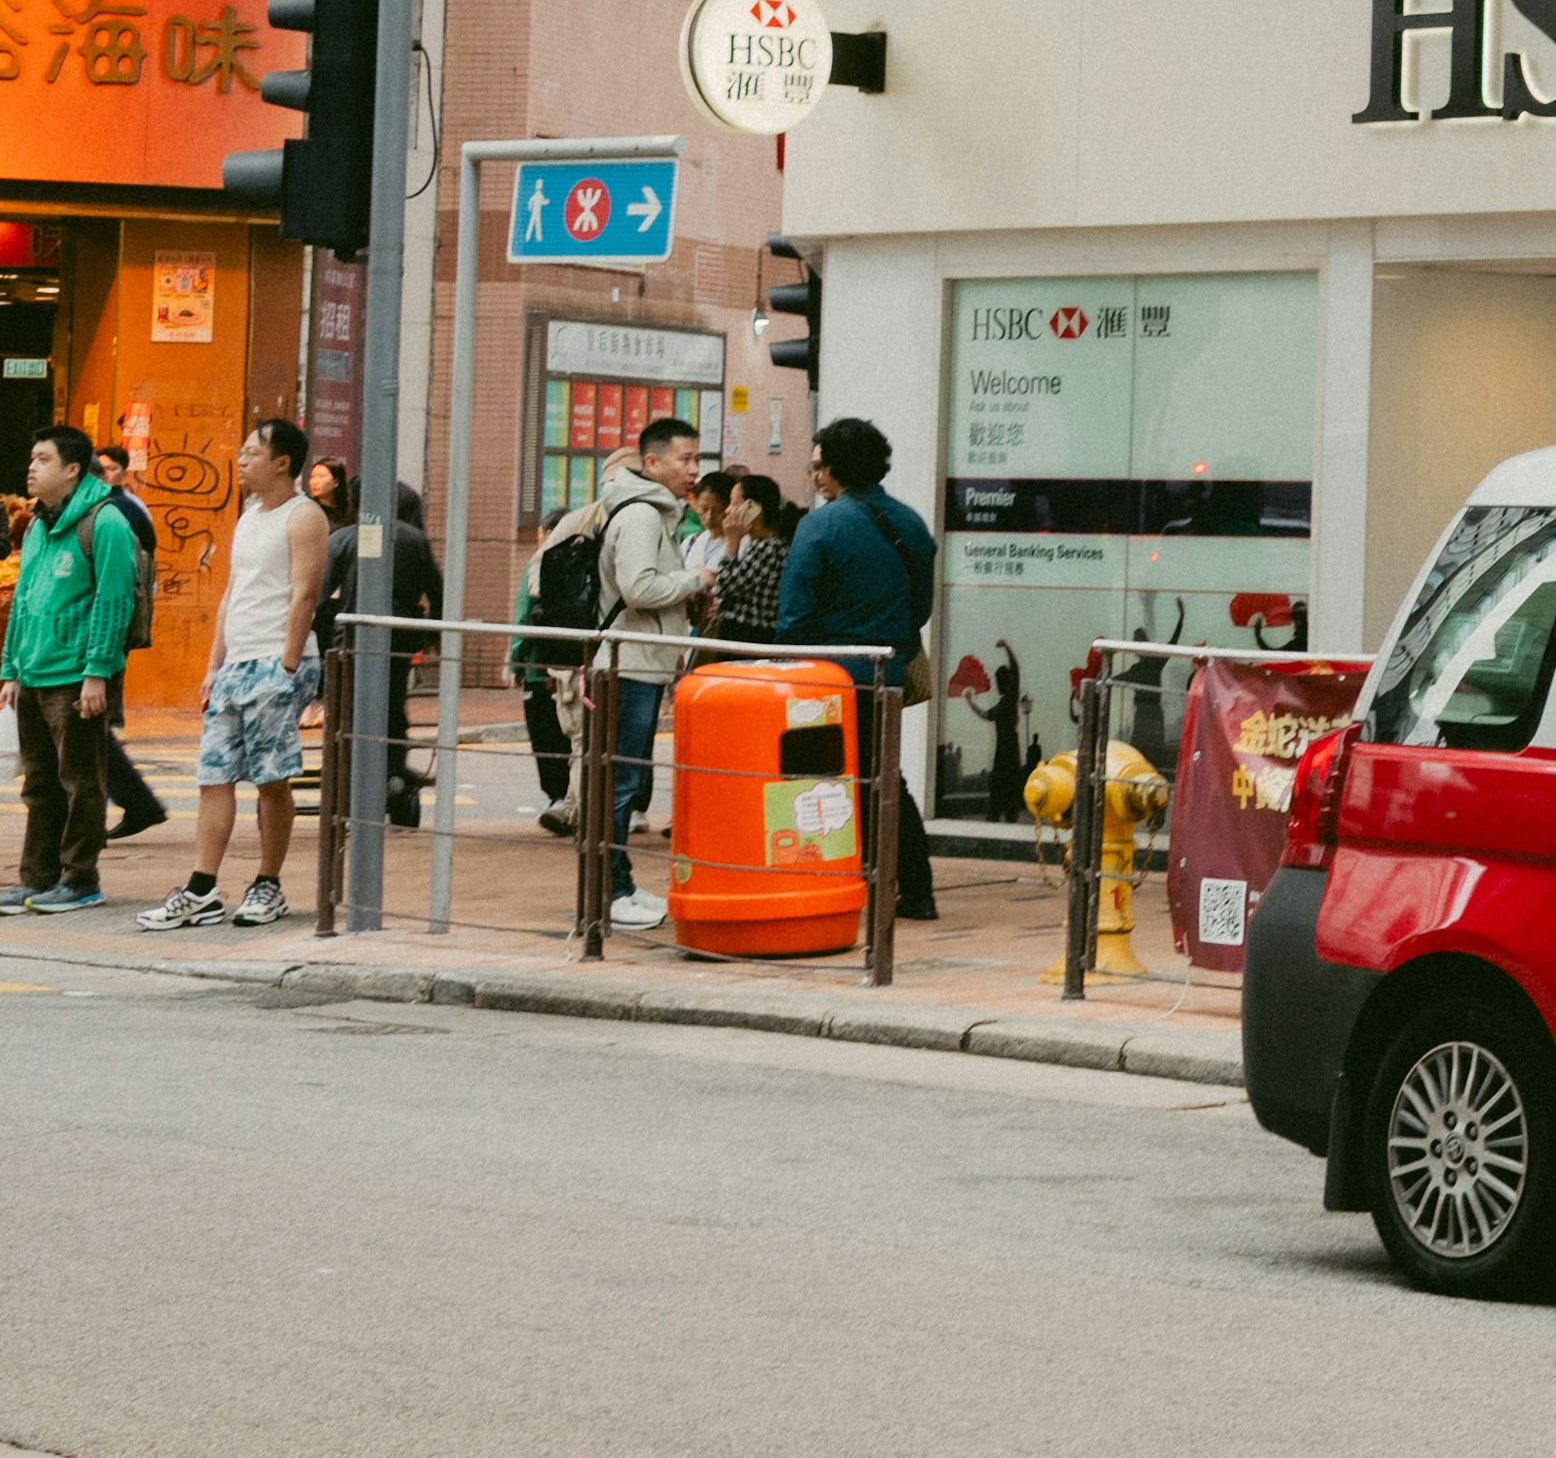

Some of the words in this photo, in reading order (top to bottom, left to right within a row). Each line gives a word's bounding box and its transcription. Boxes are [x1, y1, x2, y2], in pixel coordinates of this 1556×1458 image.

[728, 33, 817, 70] HSBC
[972, 308, 1043, 341] HSBC
[970, 370, 1062, 396] Welcome
[965, 486, 1017, 507] Premier
[1008, 544, 1054, 562] Banking
[1056, 545, 1104, 560] Services
